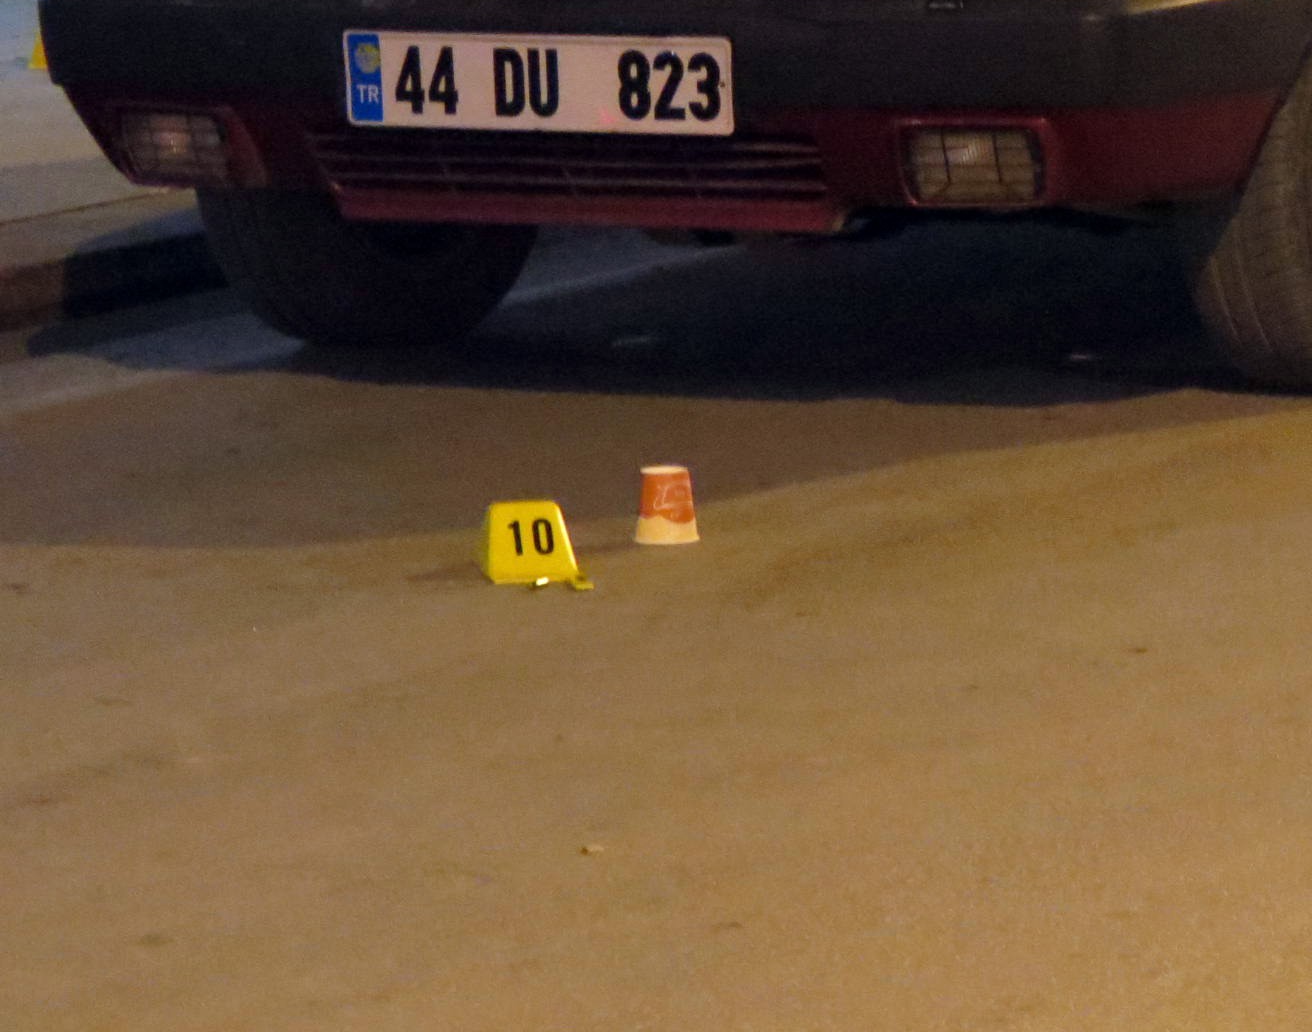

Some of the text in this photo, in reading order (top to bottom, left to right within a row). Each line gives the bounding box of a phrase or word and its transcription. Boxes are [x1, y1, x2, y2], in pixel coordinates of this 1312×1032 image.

[356, 45, 721, 122] TR 44 DU 823
[508, 518, 554, 557] 10
